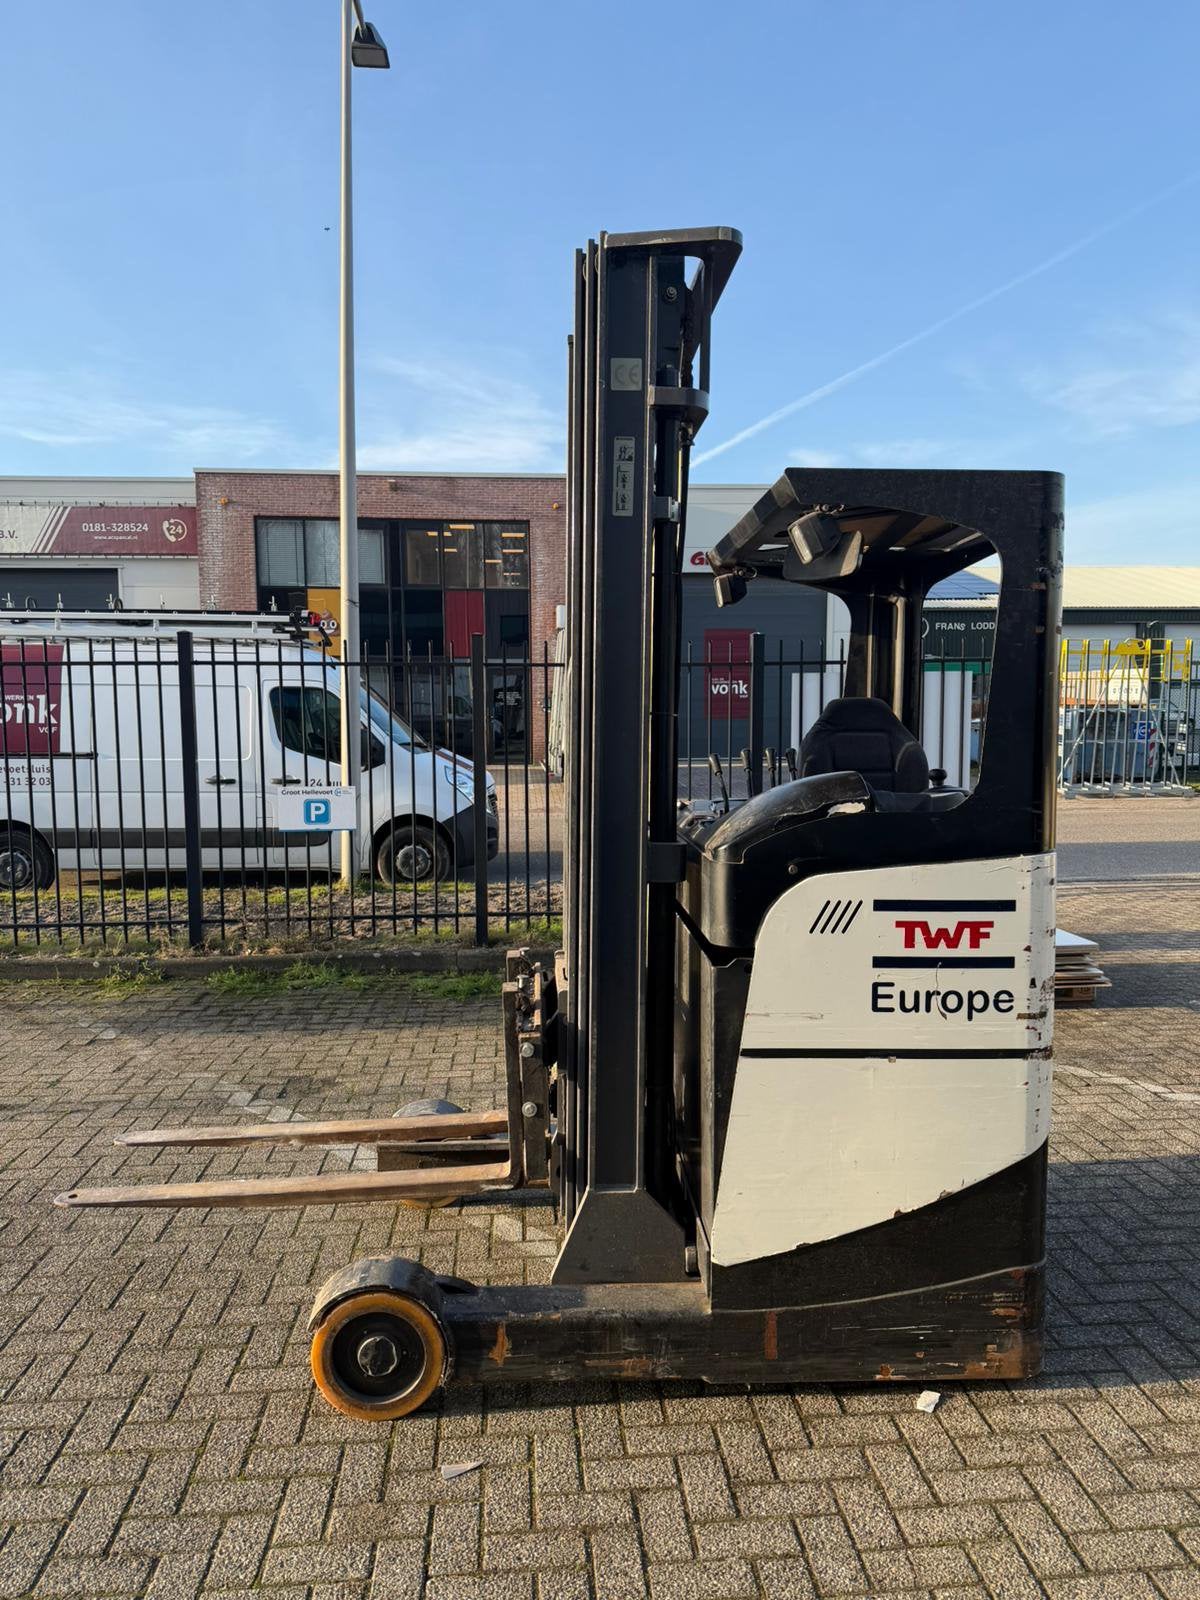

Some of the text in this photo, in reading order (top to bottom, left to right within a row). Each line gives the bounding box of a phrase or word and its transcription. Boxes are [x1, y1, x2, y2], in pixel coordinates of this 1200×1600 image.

[82, 522, 148, 532] 0181-328524
[169, 525, 183, 534] 24
[935, 622, 966, 631] FRANS
[711, 680, 748, 694] vonk
[311, 802, 326, 821] P
[895, 920, 994, 949] TWF
[871, 981, 1015, 1022] Europe
